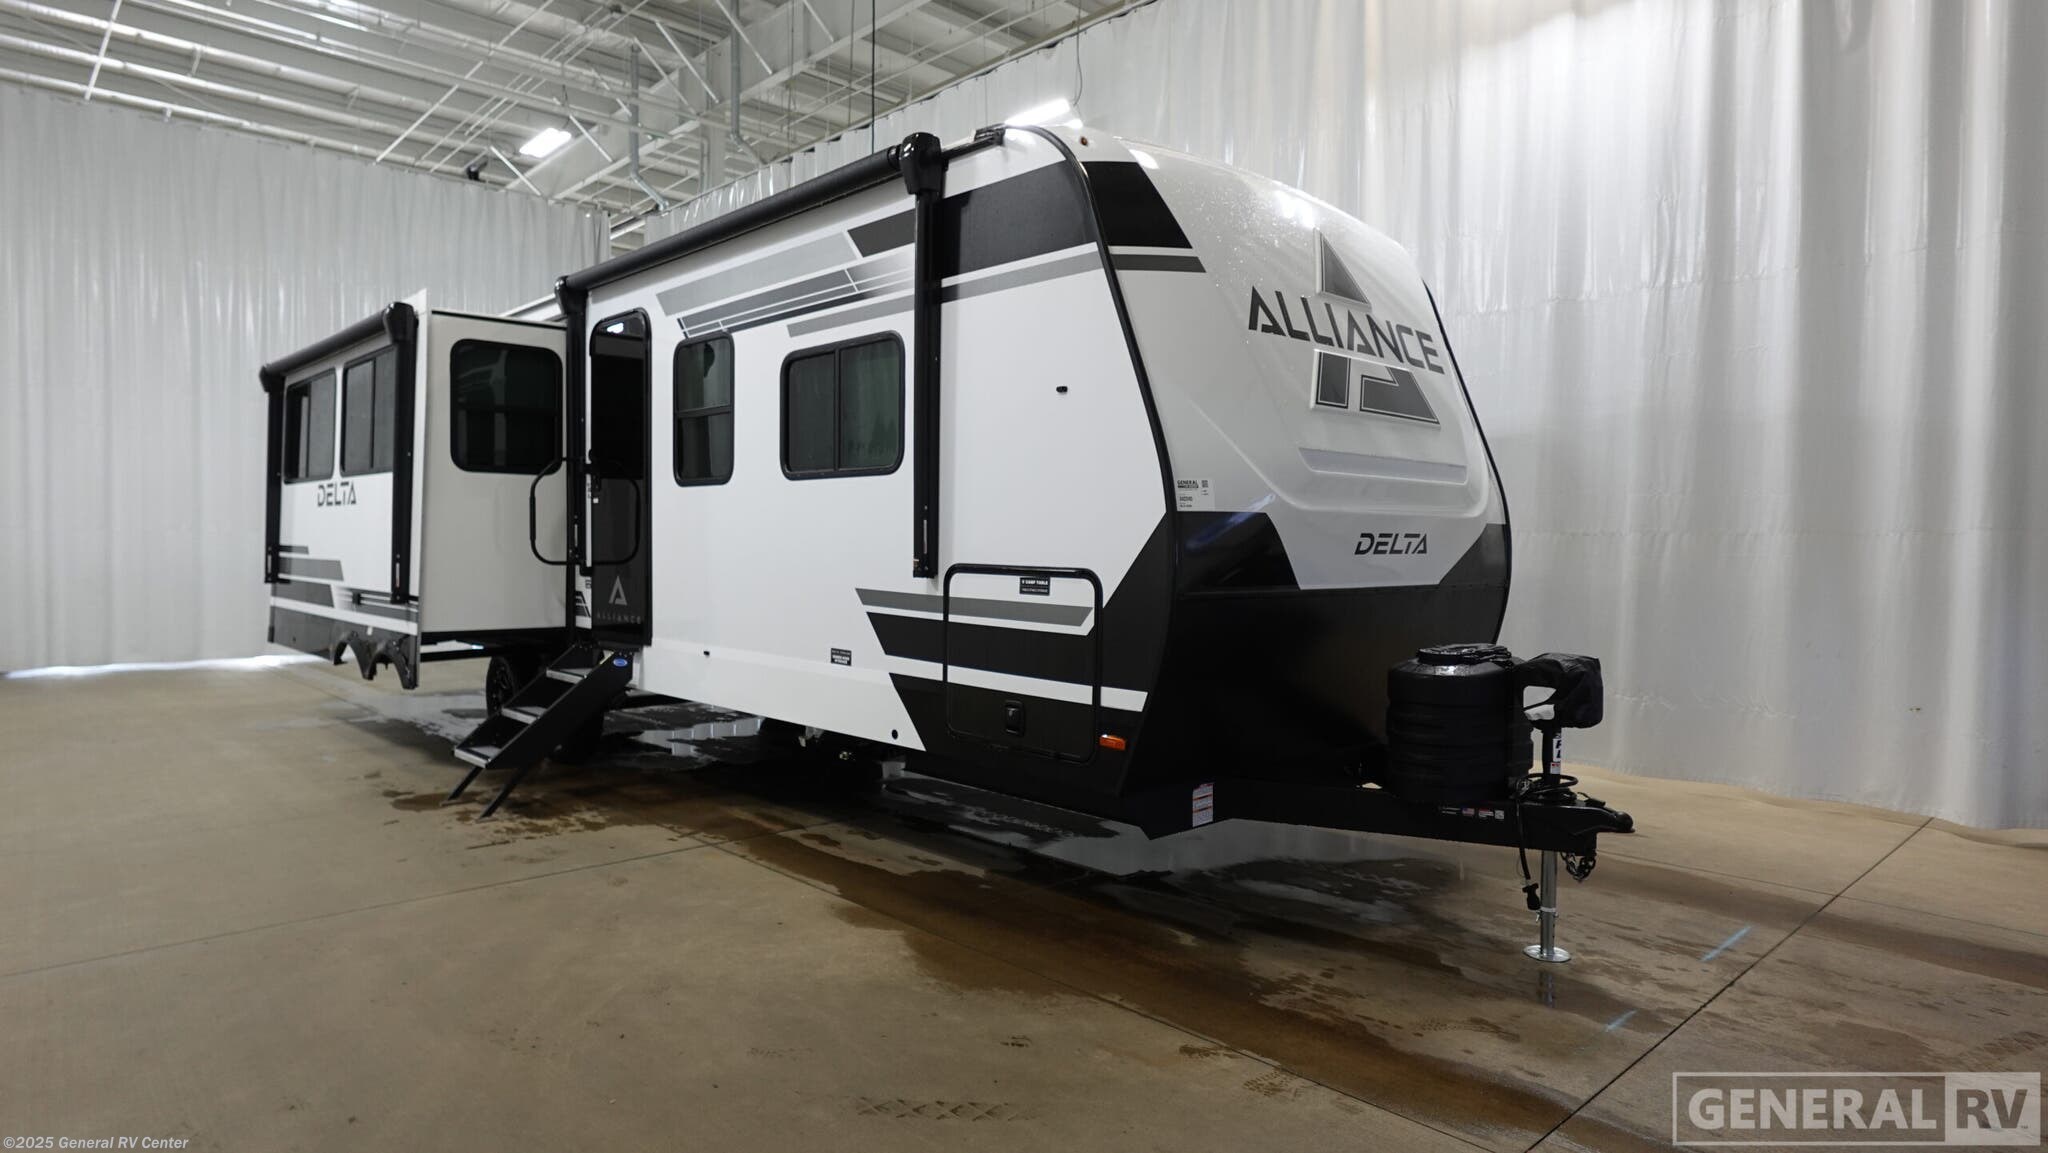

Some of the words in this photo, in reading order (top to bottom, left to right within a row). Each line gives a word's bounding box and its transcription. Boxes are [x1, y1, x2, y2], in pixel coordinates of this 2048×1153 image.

[1248, 285, 1445, 375] ALLIANCE
[317, 481, 357, 507] DELTA
[1354, 532, 1428, 555] DELTA
[597, 610, 641, 624] ALLIANCE
